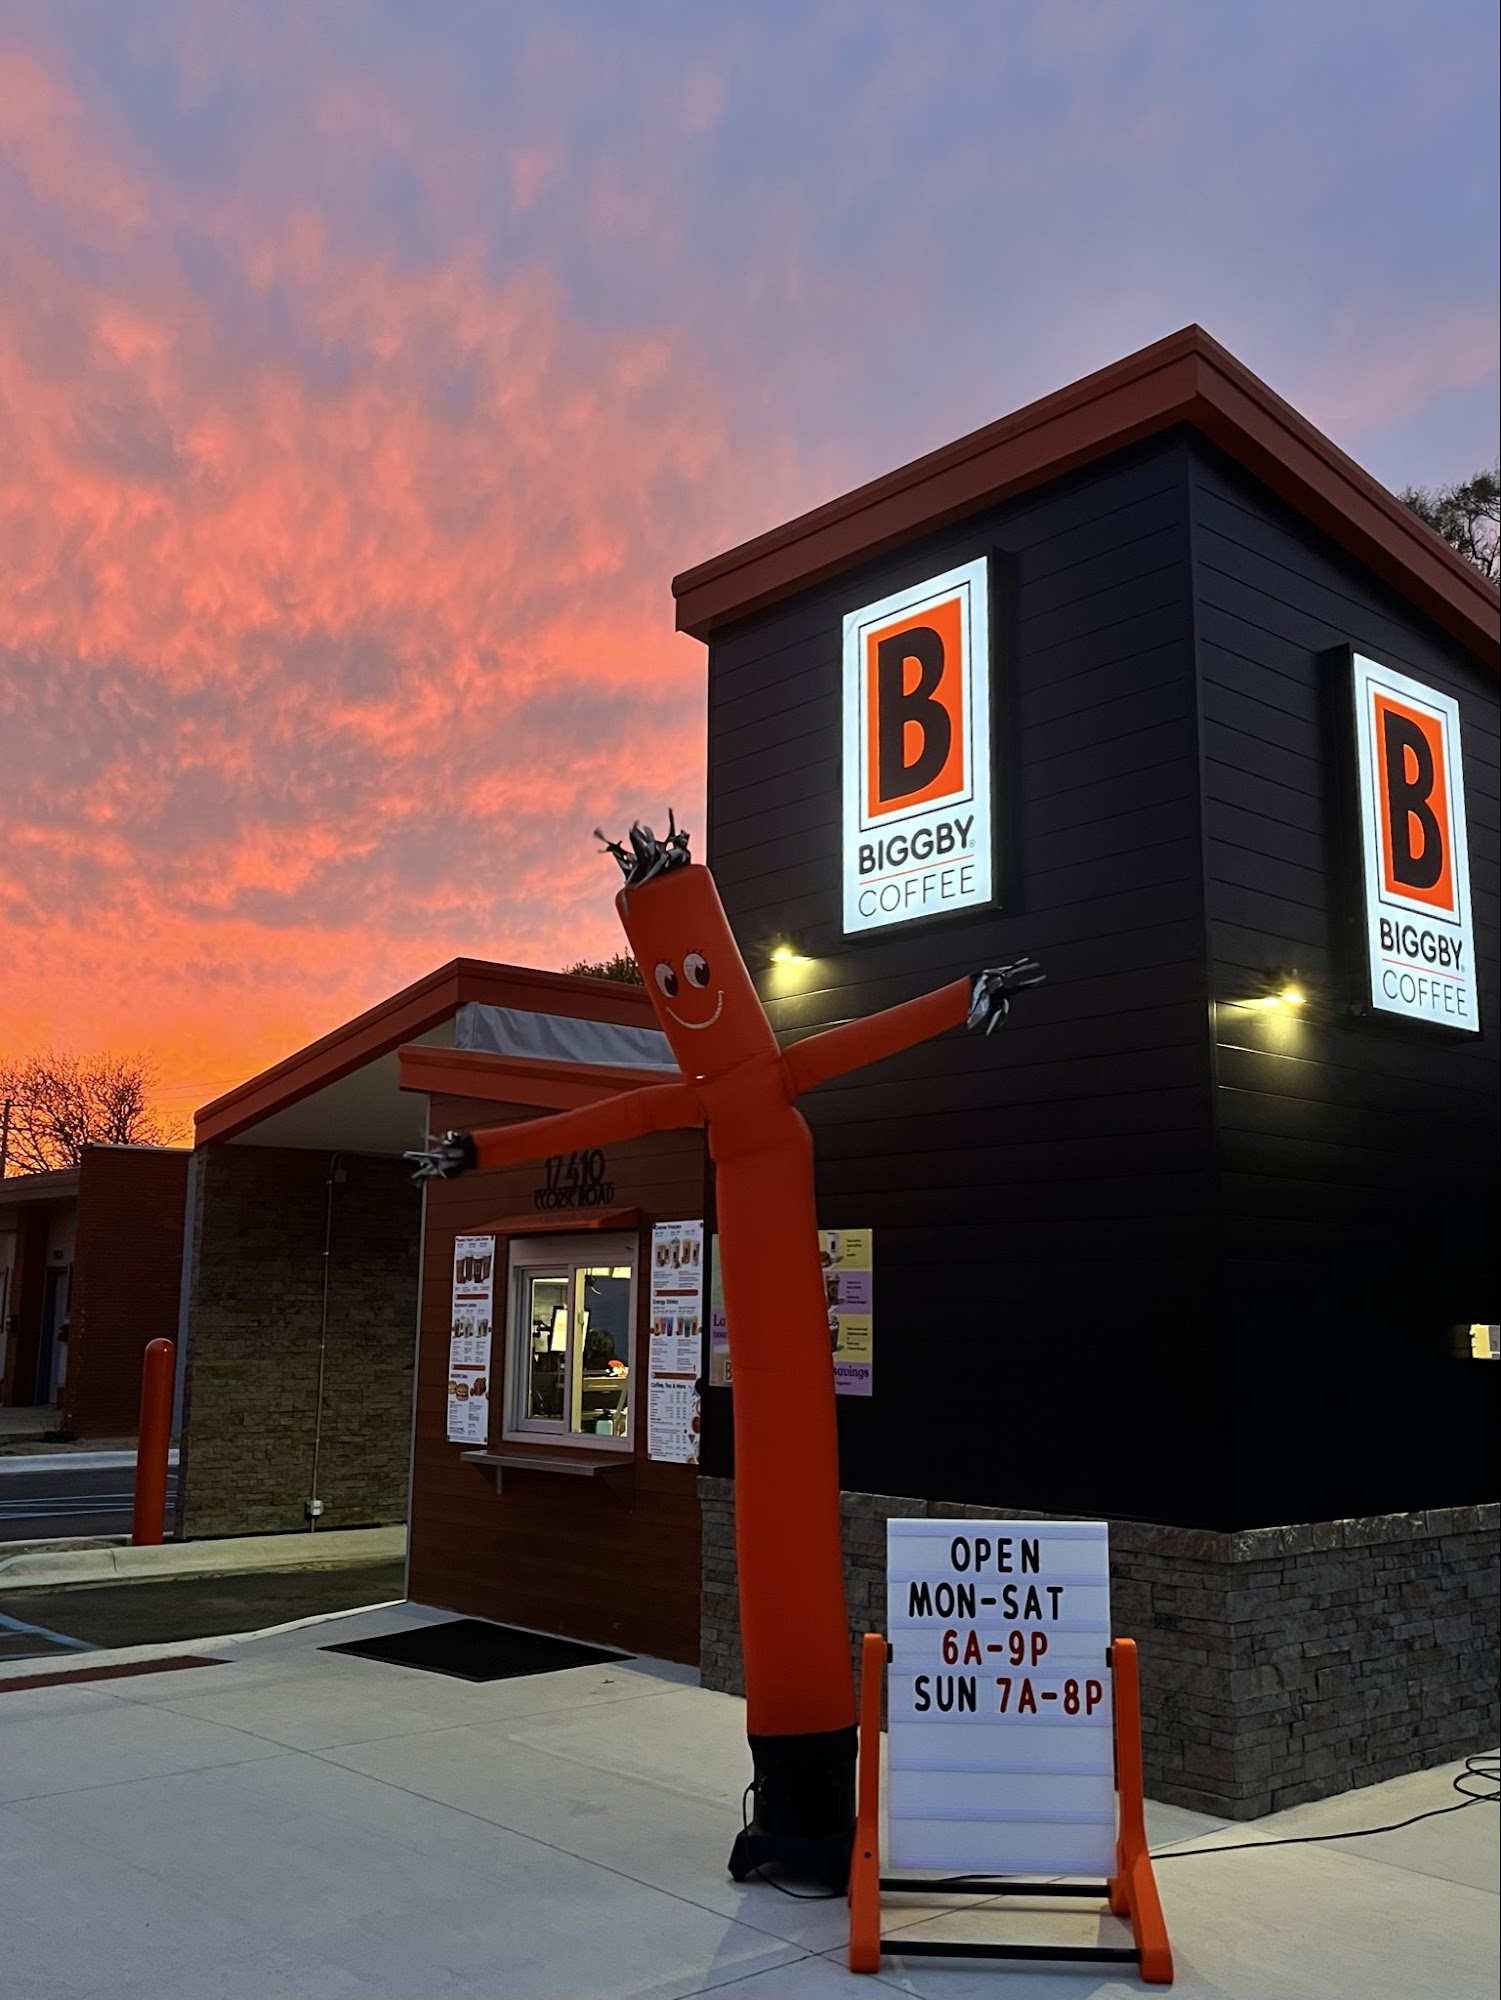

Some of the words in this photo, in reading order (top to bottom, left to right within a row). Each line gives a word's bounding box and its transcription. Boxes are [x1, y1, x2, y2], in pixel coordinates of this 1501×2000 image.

[878, 626, 952, 803] B
[1383, 708, 1443, 889] B
[858, 815, 975, 875] BIGGBY
[858, 865, 976, 917] COFFEE
[1380, 917, 1463, 971] BIGGBY
[1382, 969, 1468, 1017] COFFEE
[951, 1536, 1040, 1573] OPEN
[908, 1581, 1064, 1620] MON-SAT
[942, 1629, 1048, 1667] 6A-9P
[914, 1675, 977, 1712] SUN
[996, 1677, 1103, 1716] 7A-8P
